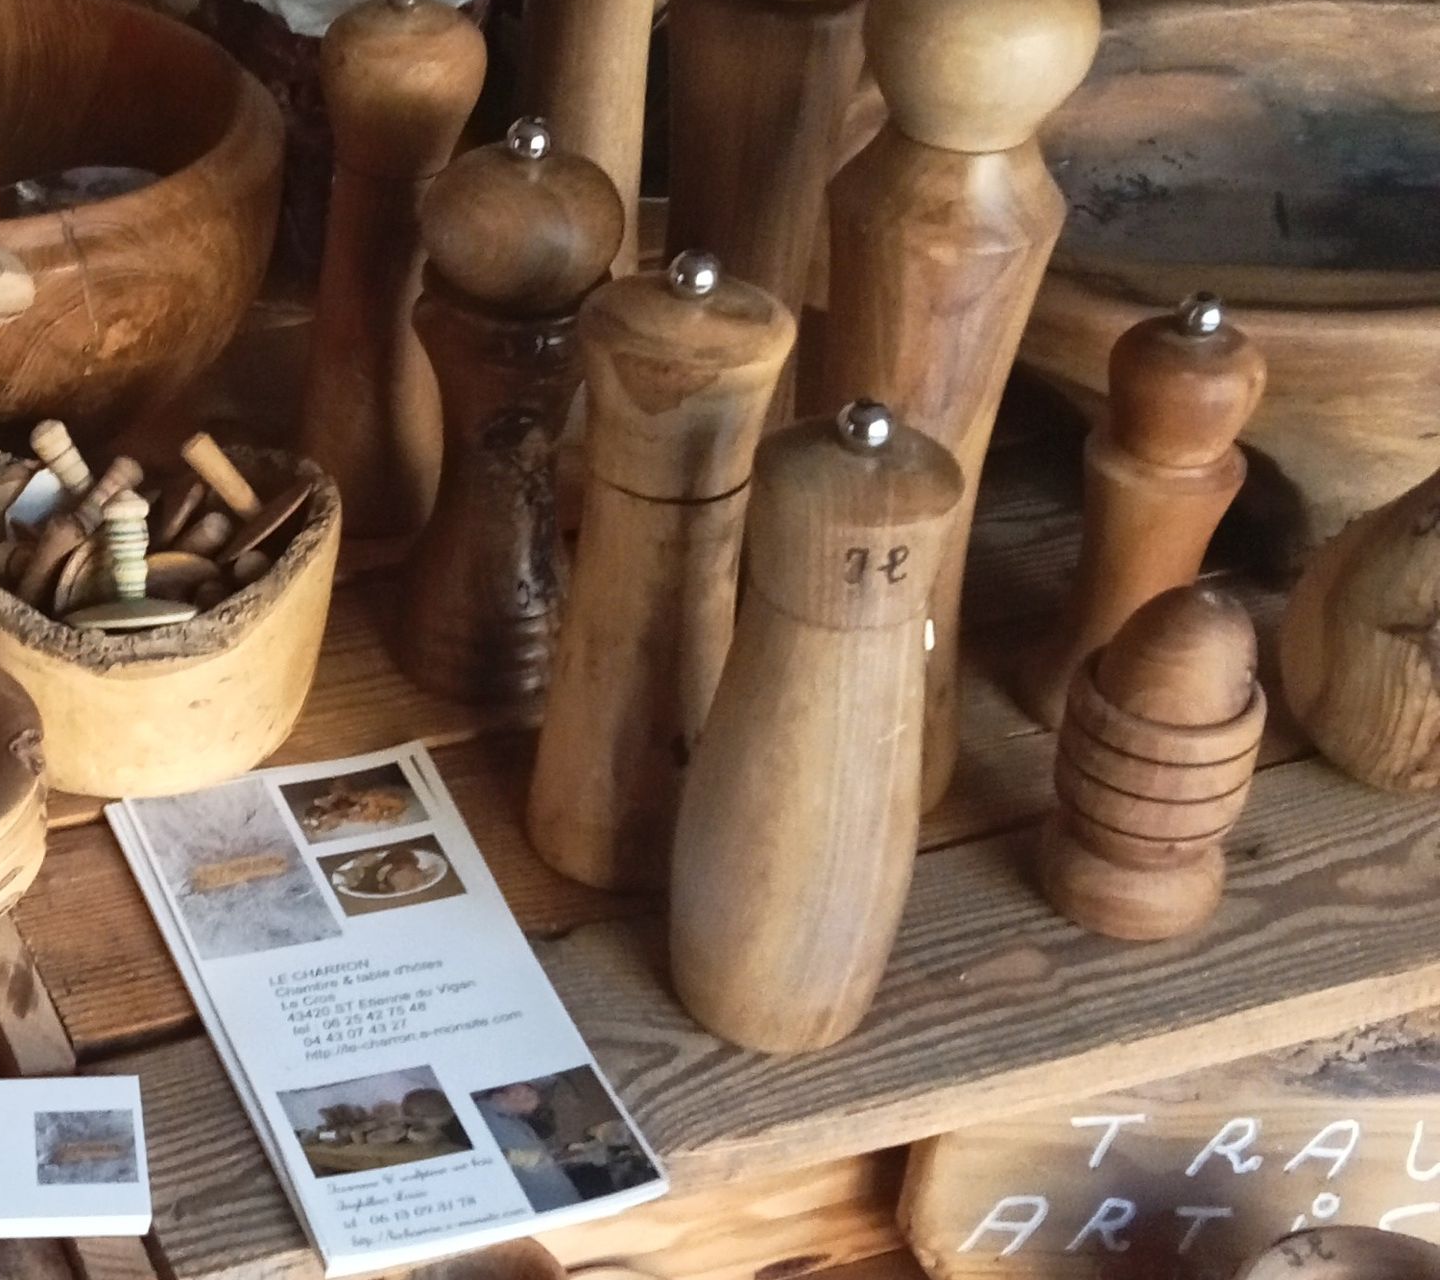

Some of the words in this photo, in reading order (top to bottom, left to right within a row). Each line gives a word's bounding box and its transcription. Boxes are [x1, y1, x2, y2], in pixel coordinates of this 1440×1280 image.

[269, 974, 287, 987] LE
[291, 959, 370, 982] CHARRON
[274, 979, 339, 998] Chambre
